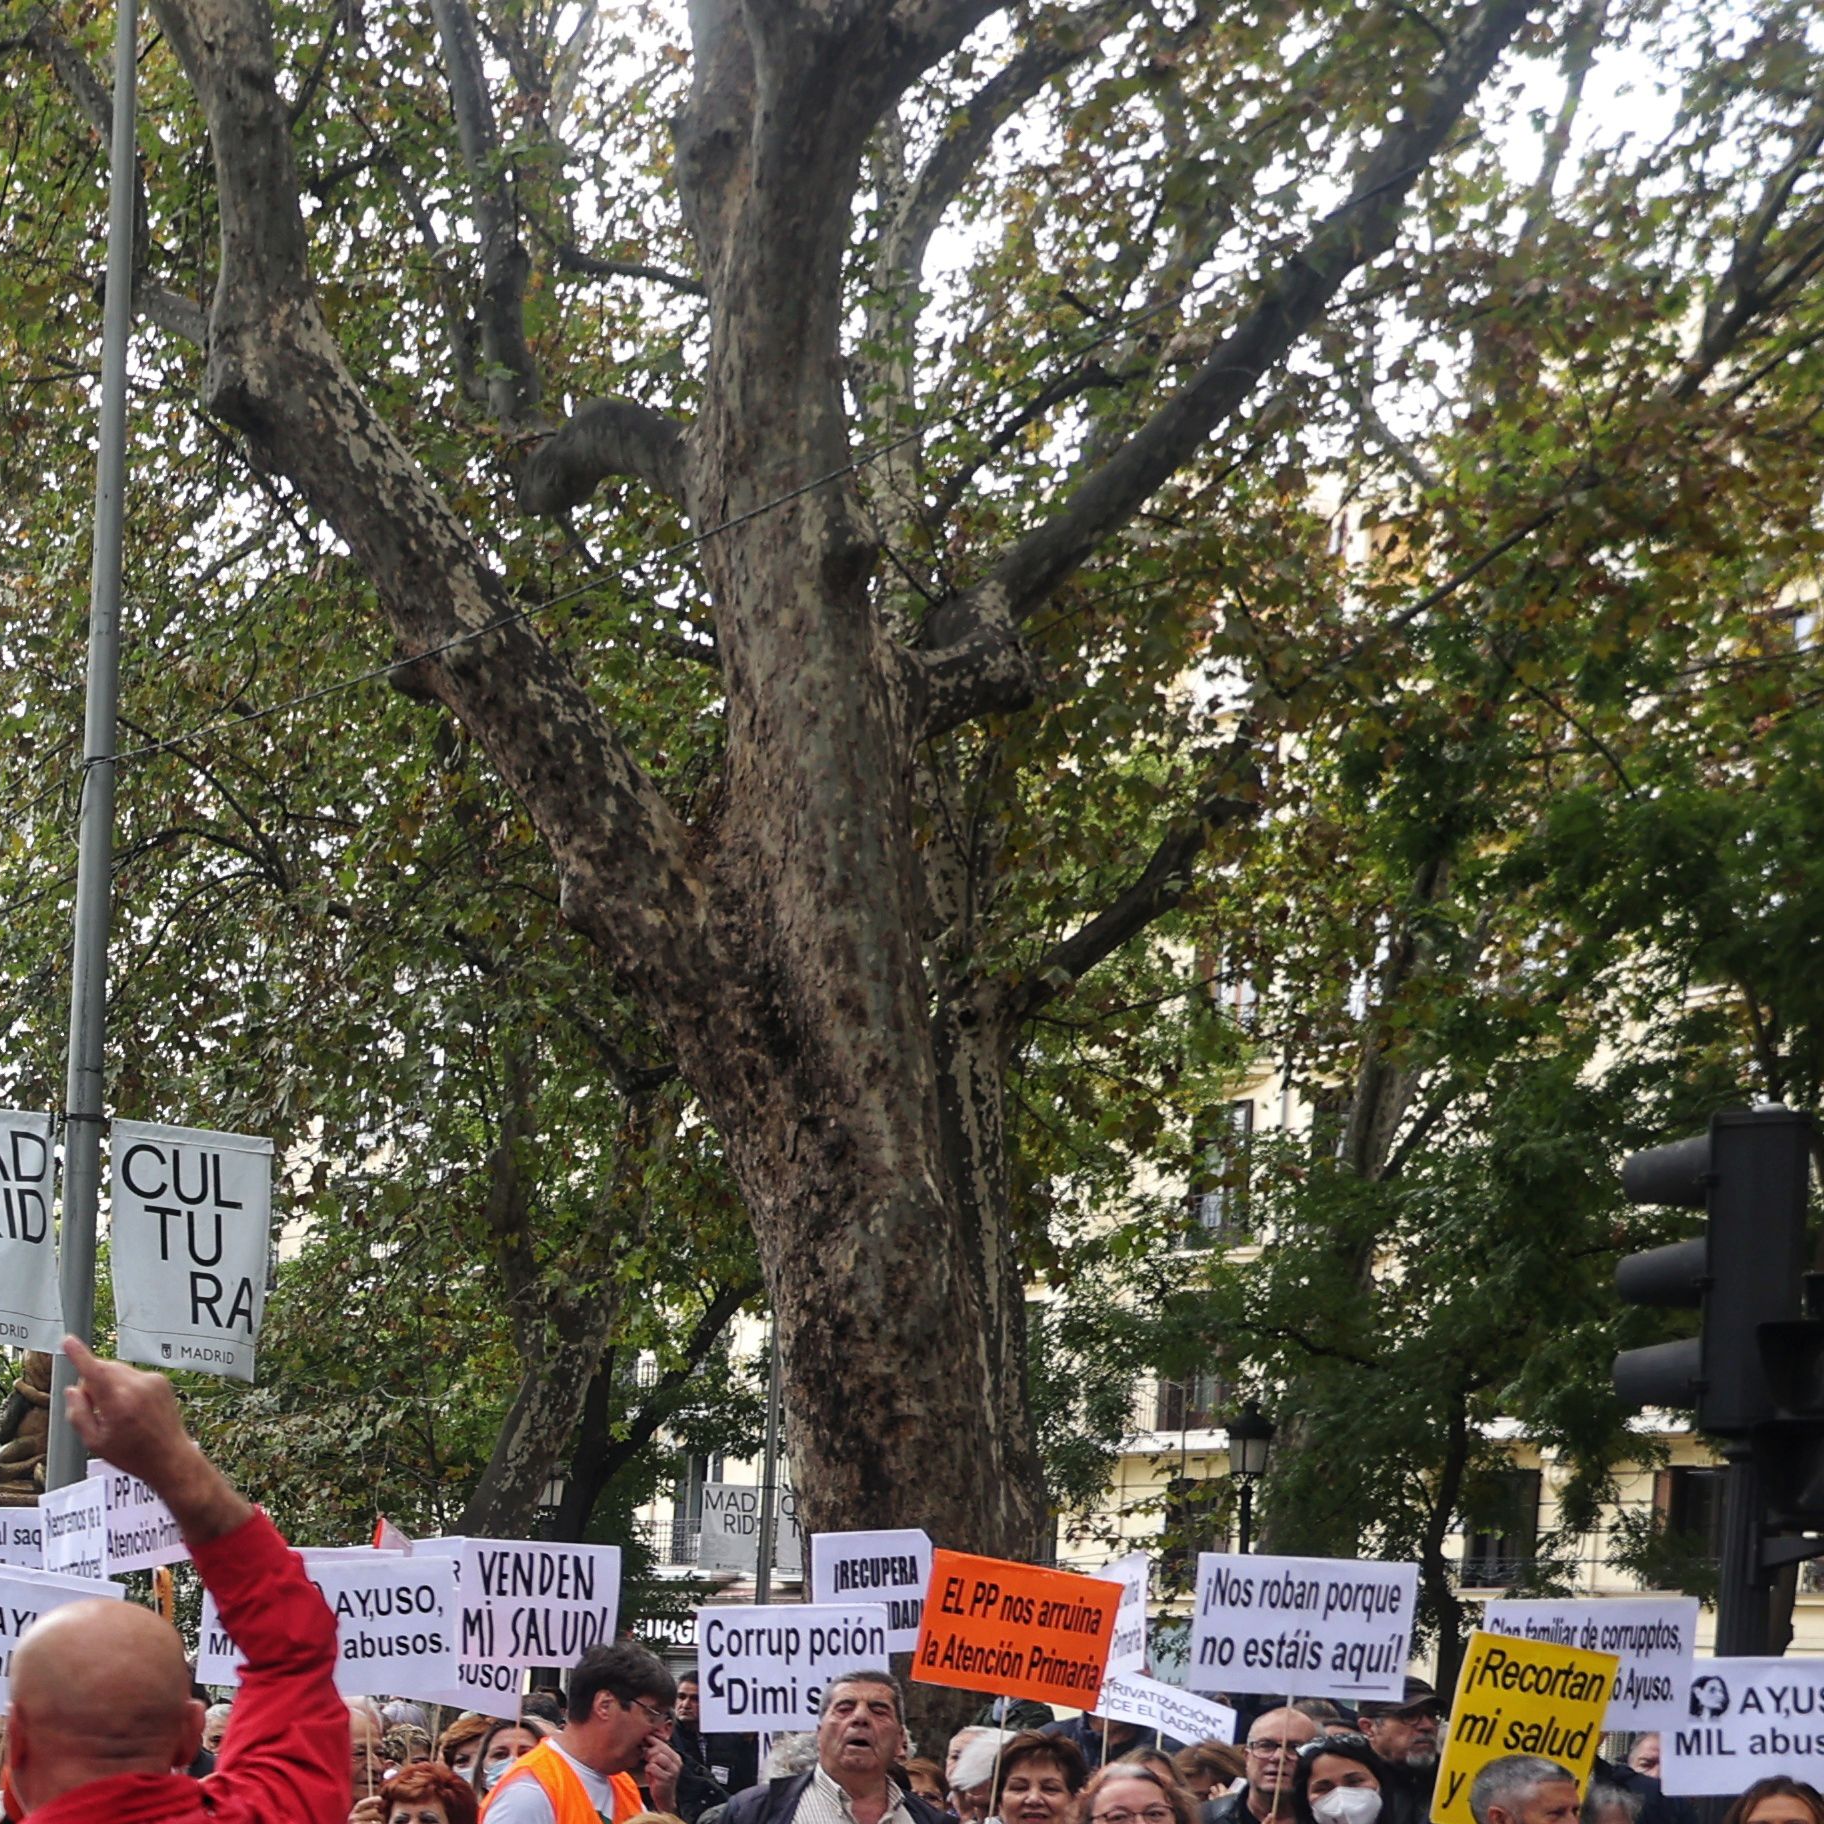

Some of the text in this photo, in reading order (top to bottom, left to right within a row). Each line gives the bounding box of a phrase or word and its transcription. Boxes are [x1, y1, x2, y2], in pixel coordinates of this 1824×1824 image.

[120, 1143, 243, 1210] CUL
[143, 1204, 223, 1268] TU
[189, 1271, 254, 1335] RA
[180, 1344, 235, 1365] MADRID
[114, 1476, 130, 1510] PP
[705, 1490, 756, 1514] MAD
[107, 1519, 156, 1561] Atención
[724, 1513, 755, 1535] RID
[478, 1550, 595, 1600] VENDEN
[833, 1555, 918, 1593] ¡RECUPERA
[1203, 1567, 1401, 1622] ¡Nos roban porque
[940, 1576, 1103, 1636] EL PP nos arruina
[344, 1630, 451, 1660] abusos.
[509, 1606, 609, 1658] SALUD!
[707, 1617, 885, 1665] Corrup pción
[1525, 1616, 1577, 1648] familiar
[1580, 1616, 1599, 1651] de
[921, 1629, 1103, 1692] la Atención Primaria.
[1199, 1628, 1404, 1682] no estáis aquí!
[1464, 1647, 1606, 1703] ¡Recortan
[727, 1676, 796, 1716] Dimi
[1625, 1667, 1674, 1708] Ayuso.
[1137, 1702, 1156, 1720] EL
[1454, 1707, 1595, 1762] mi salud
[1675, 1729, 1736, 1756] MIL
[1442, 1770, 1467, 1809] y
